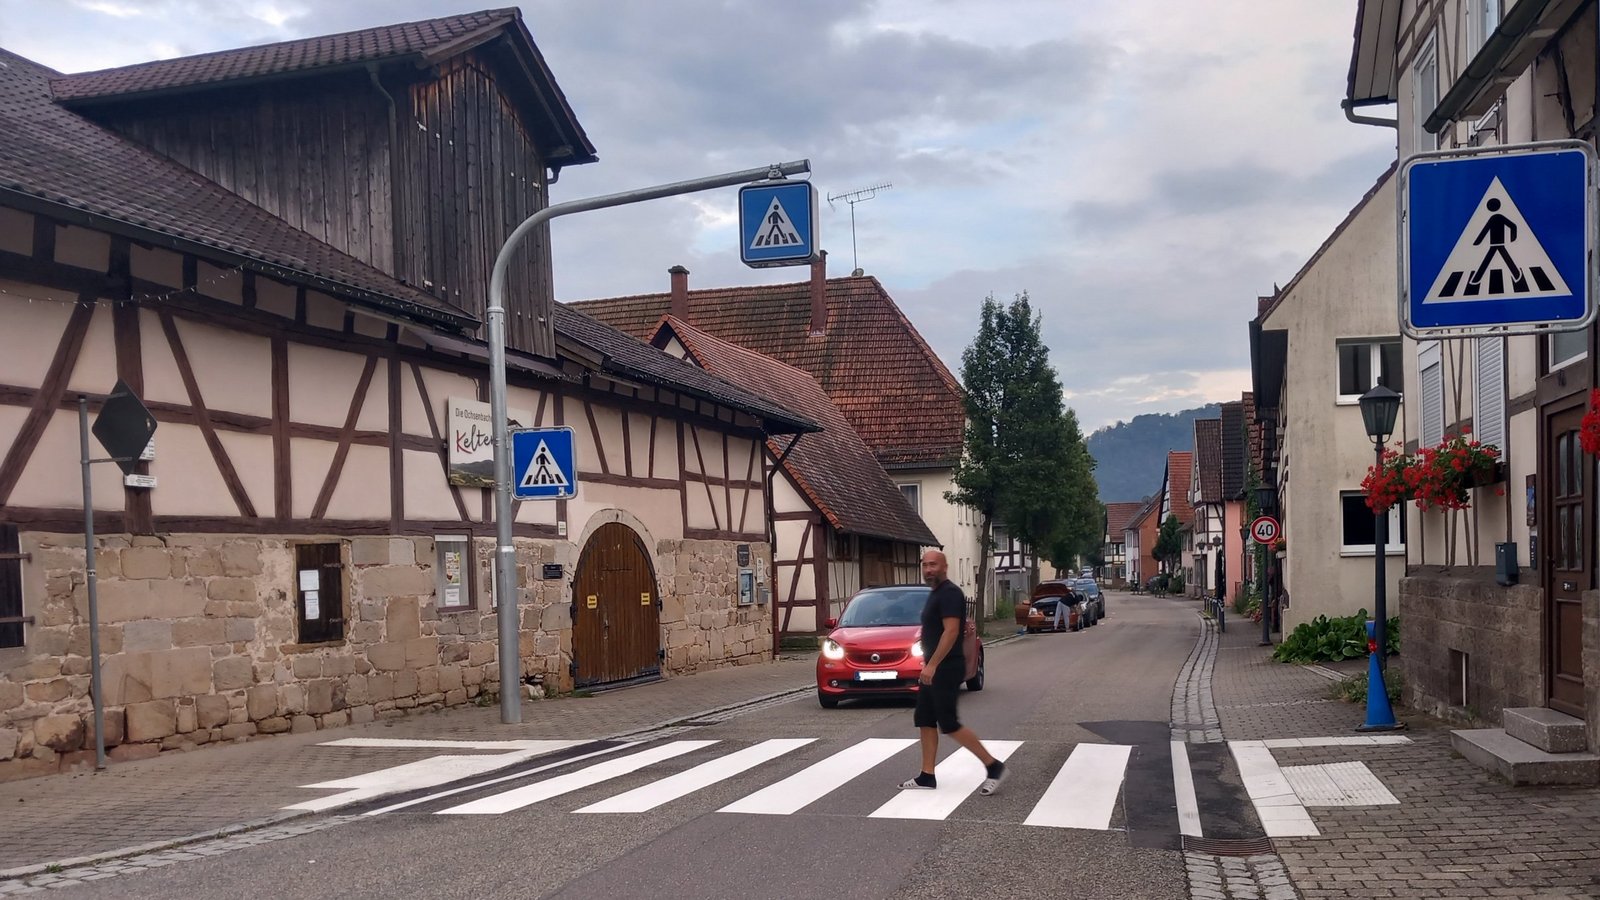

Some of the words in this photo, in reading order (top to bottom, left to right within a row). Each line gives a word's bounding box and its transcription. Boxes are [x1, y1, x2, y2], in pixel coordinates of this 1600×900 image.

[455, 407, 463, 417] Die
[464, 409, 491, 422] Ochsenbach
[1257, 524, 1273, 536] 40
